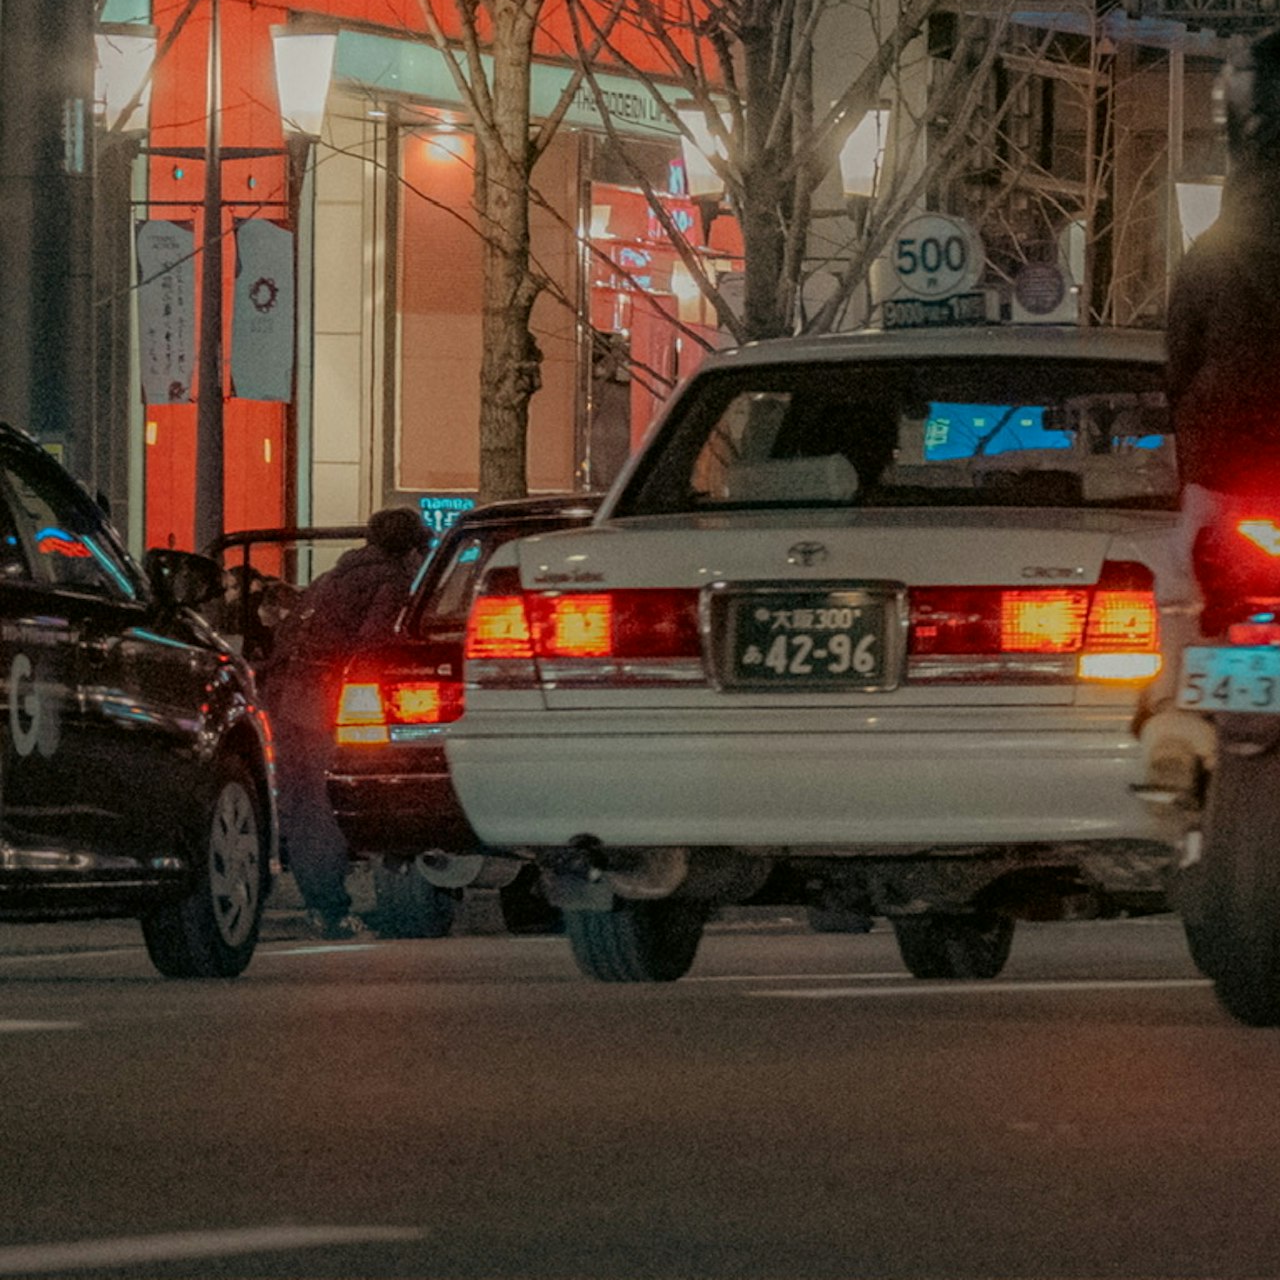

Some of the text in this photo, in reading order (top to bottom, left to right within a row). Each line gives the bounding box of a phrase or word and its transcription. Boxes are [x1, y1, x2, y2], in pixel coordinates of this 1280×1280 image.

[897, 236, 965, 275] 500
[771, 608, 852, 629] 大阪 300
[765, 633, 876, 675] 42-96
